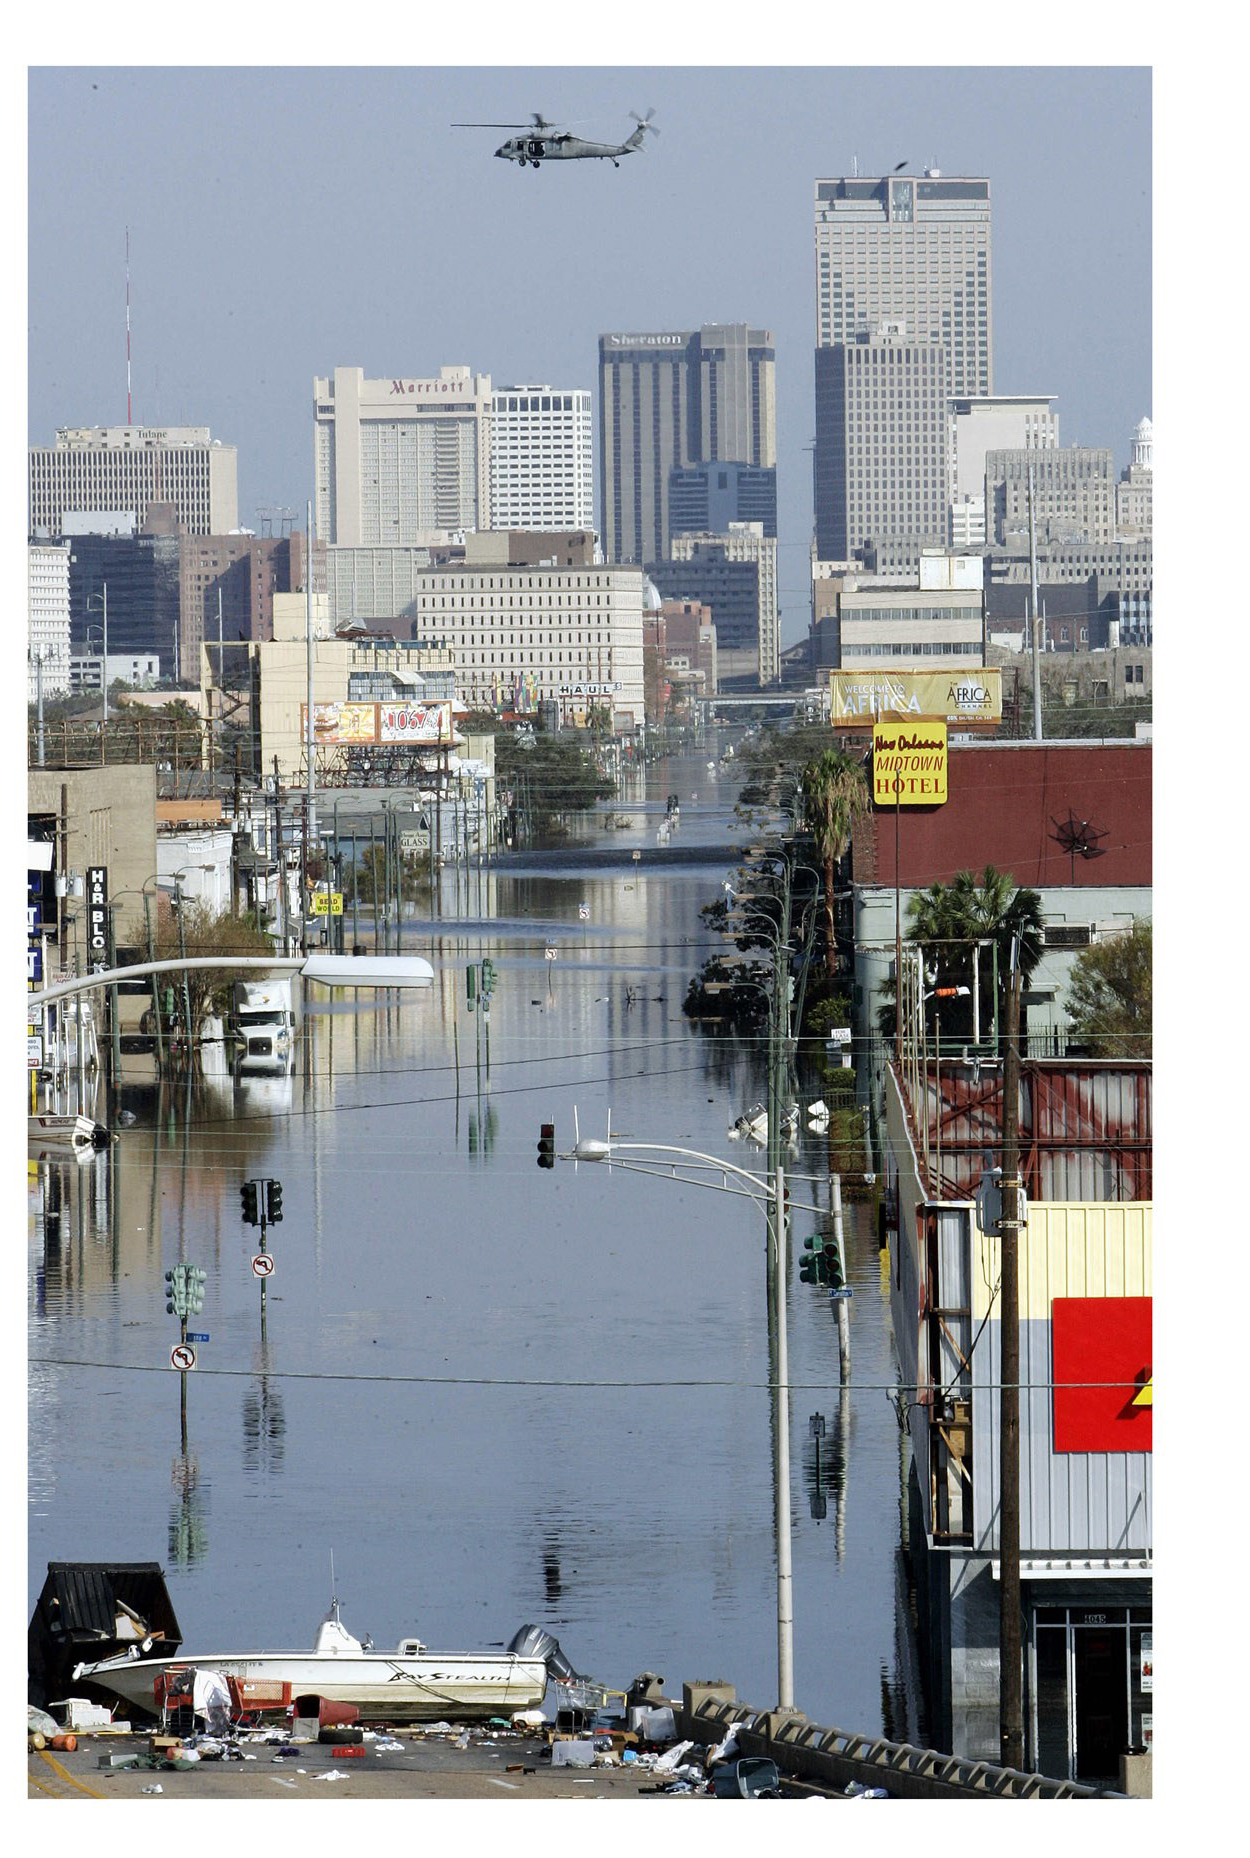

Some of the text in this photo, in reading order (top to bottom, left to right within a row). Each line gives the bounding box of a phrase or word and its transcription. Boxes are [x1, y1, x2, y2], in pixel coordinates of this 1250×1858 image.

[611, 335, 681, 345] Sheraton
[390, 379, 463, 395] Marriott
[136, 430, 167, 439] Tulane
[845, 685, 890, 694] WELCOME
[947, 687, 992, 702] AFRICA
[842, 693, 922, 715] AFRICA
[875, 733, 944, 753] New Orleans
[876, 756, 943, 771] MIDTOWN
[876, 778, 945, 794] HOTEL
[401, 838, 428, 847] GLASS
[91, 870, 105, 904] H&R
[1084, 1614, 1106, 1624] 4045
